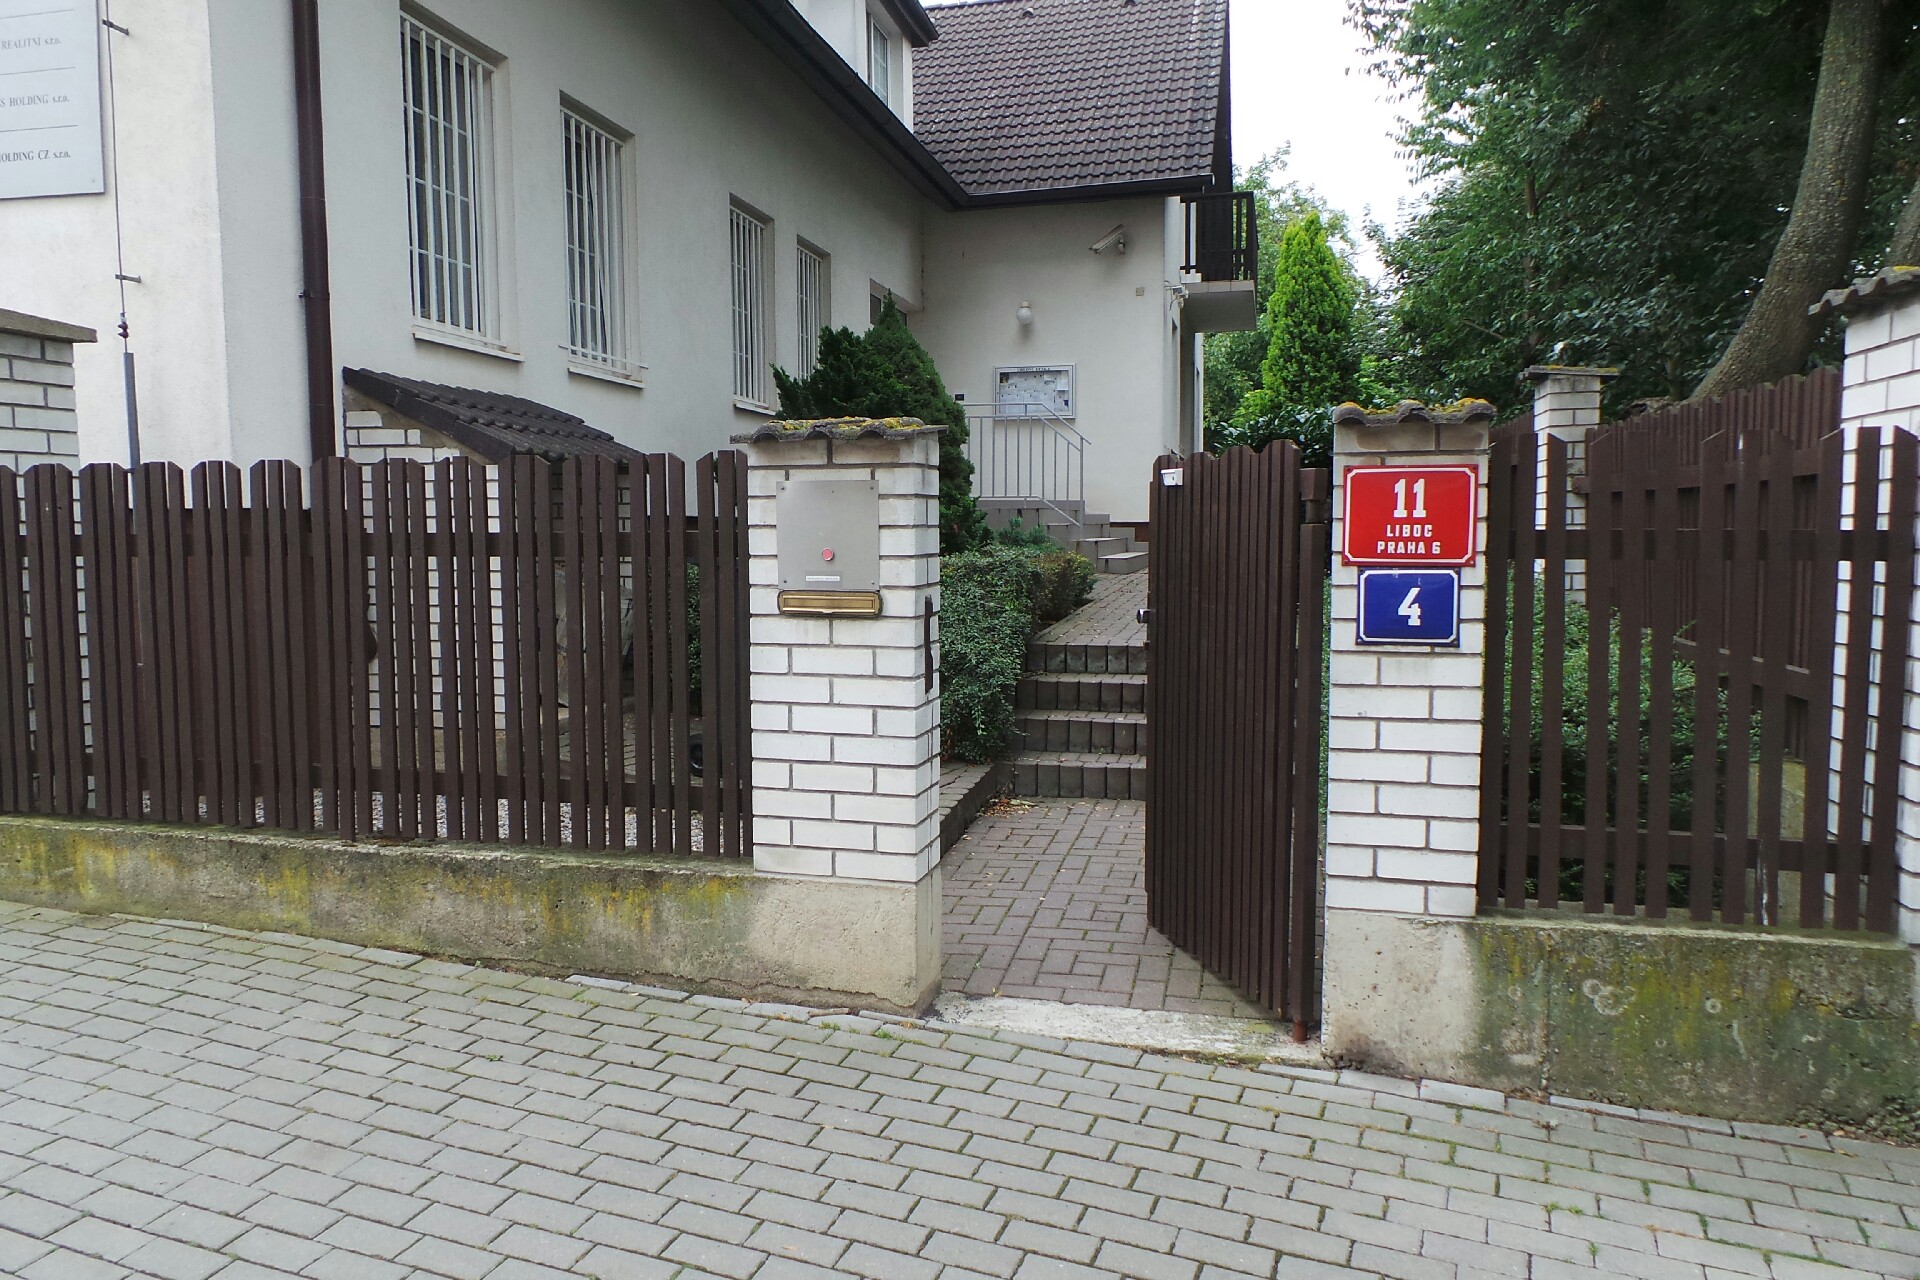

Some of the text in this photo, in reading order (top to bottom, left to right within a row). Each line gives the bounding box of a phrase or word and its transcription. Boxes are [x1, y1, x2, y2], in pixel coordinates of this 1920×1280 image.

[44, 37, 62, 46] s.r.o.
[9, 94, 49, 107] HOLDING
[52, 95, 70, 103] s.r.o.
[0, 149, 71, 162] OLDING CZ s.r.o.
[1393, 478, 1427, 518] 11
[1386, 524, 1433, 538] LIBOC
[1377, 541, 1441, 554] PRAHA 6
[1397, 587, 1422, 626] 4
